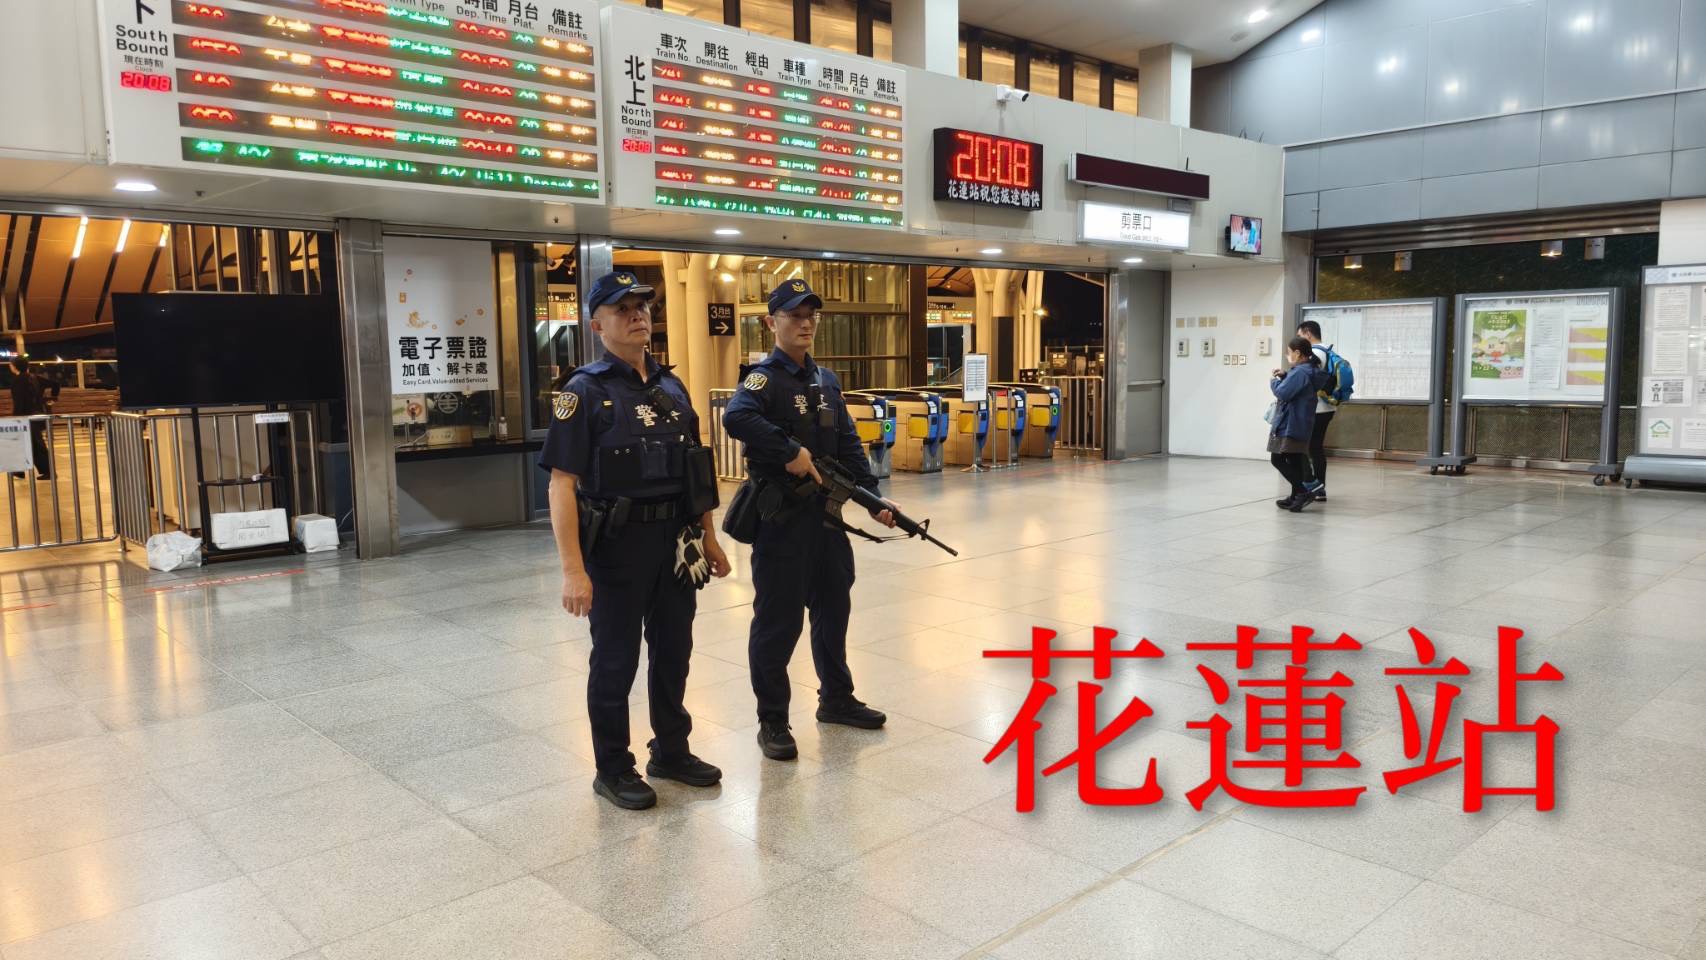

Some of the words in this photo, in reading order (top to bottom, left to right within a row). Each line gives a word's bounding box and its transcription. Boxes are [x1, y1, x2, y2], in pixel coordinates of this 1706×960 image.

[456, 5, 480, 19] Dep.
[482, 11, 507, 24] Time
[547, 24, 588, 41] Remarks
[551, 8, 583, 30] 備註
[116, 24, 168, 43] South
[116, 38, 169, 56] Bound
[656, 48, 676, 59] Train
[696, 56, 738, 72] Destination
[751, 67, 764, 77] Via
[778, 72, 795, 83] Train
[797, 77, 812, 87] Type
[818, 80, 832, 90] Dep.
[834, 82, 849, 93] Time
[660, 32, 687, 53] 車次
[704, 41, 730, 61] 開往
[745, 50, 769, 70] 經由
[822, 67, 844, 84] 時間
[849, 72, 869, 89] 月台
[876, 78, 896, 94] 備註
[625, 55, 646, 106] 北上
[621, 105, 652, 118] North
[621, 115, 652, 128] Bound
[956, 133, 1029, 187] 20:08
[1121, 212, 1152, 231] 剪票口
[399, 336, 488, 360] 電子票證
[402, 361, 488, 377] 加值、解卡處
[402, 379, 417, 387] Easy
[466, 376, 489, 384] Services
